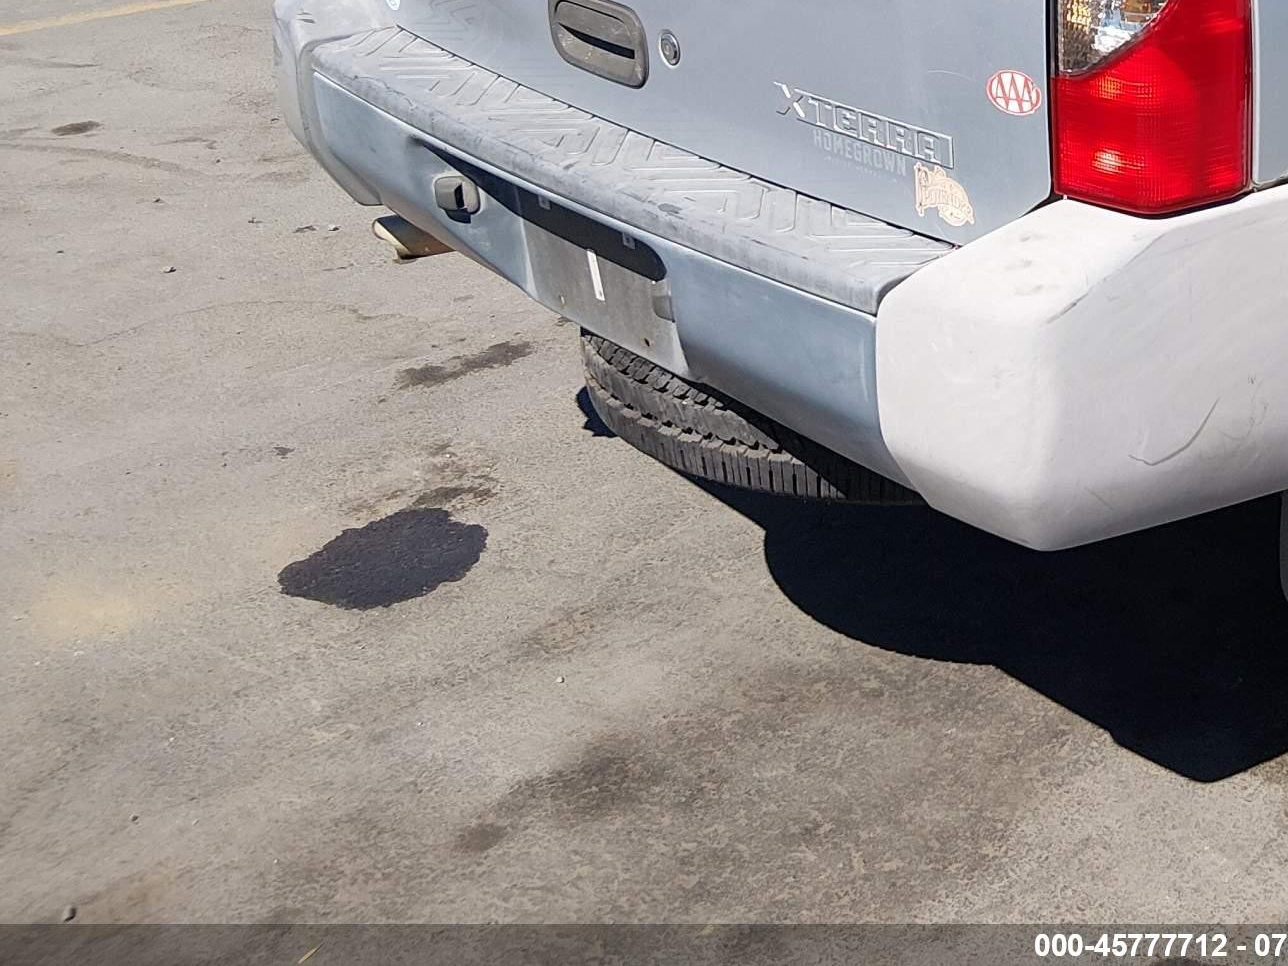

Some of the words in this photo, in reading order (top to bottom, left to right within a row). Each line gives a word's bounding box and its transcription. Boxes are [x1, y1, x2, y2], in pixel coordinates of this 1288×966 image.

[992, 72, 1034, 113] AAA
[773, 81, 954, 169] XTERRA
[813, 129, 906, 176] HOMEGROWN
